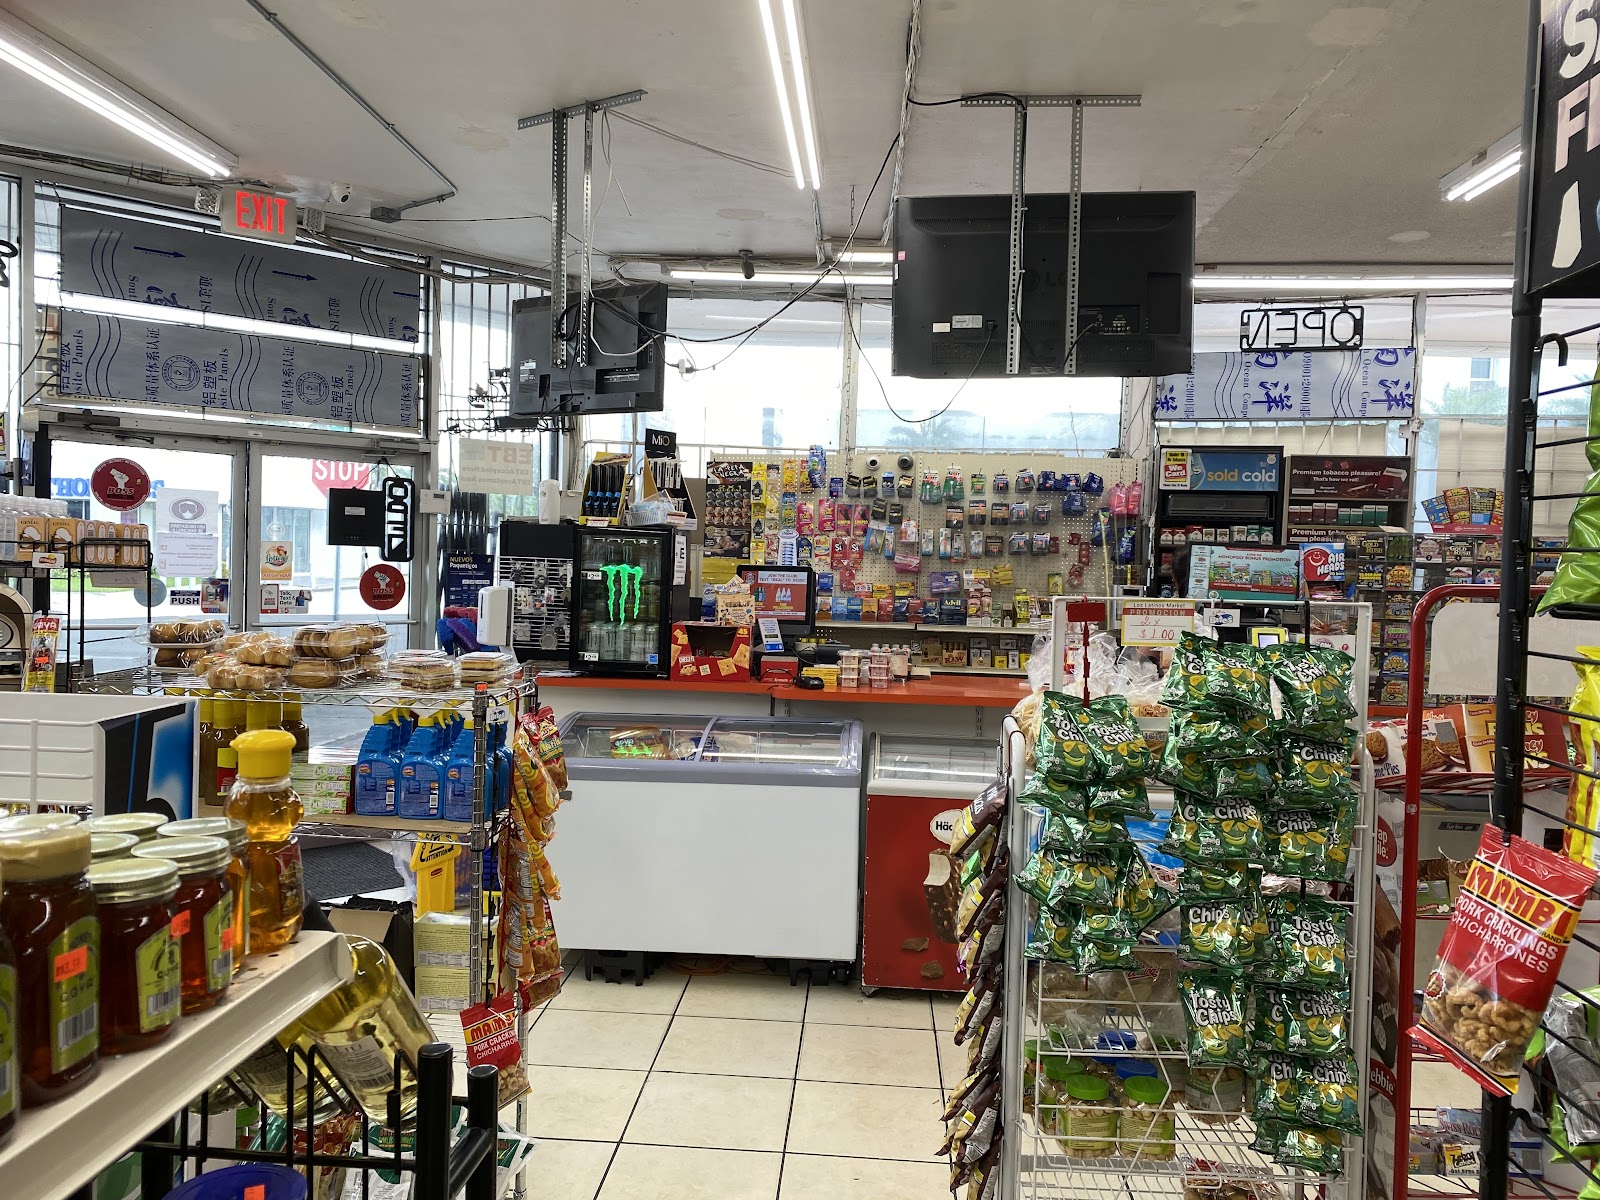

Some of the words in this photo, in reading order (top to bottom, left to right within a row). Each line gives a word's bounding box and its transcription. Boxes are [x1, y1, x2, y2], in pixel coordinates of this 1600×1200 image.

[1560, 0, 1600, 78] S
[1555, 72, 1600, 173] F
[236, 191, 288, 234] EXIT
[73, 329, 84, 365] Panels
[218, 348, 228, 382] Panels
[1207, 468, 1238, 482] sold
[1242, 468, 1276, 482] cold
[107, 487, 135, 495] BOSS
[1291, 528, 1327, 536] Premium
[1328, 553, 1345, 563] AIR
[1317, 562, 1345, 577] HEADS
[171, 597, 200, 605] PUSH
[944, 656, 964, 664] RAW
[1301, 748, 1343, 763] Chips
[1214, 805, 1257, 820] Chips
[1276, 818, 1318, 833] Chips
[425, 850, 448, 862] ATTENTION
[1465, 863, 1574, 938] MAMBI
[1189, 906, 1230, 923] Chips
[1292, 915, 1334, 933] Tosty
[1457, 895, 1482, 920] PORK
[1484, 911, 1559, 961] CRACKLINGS
[1298, 930, 1340, 947] Chips
[1451, 911, 1549, 974] CHICHARRONES
[1536, 928, 1562, 944] BRAND
[1188, 991, 1231, 1011] Tosty
[1300, 1000, 1341, 1017] Chips
[1196, 1008, 1238, 1026] Chips
[473, 1042, 489, 1053] PORK
[1312, 1066, 1352, 1084] Chips
[1370, 1067, 1394, 1096] ebbie
[1450, 1151, 1475, 1163] Zebra
